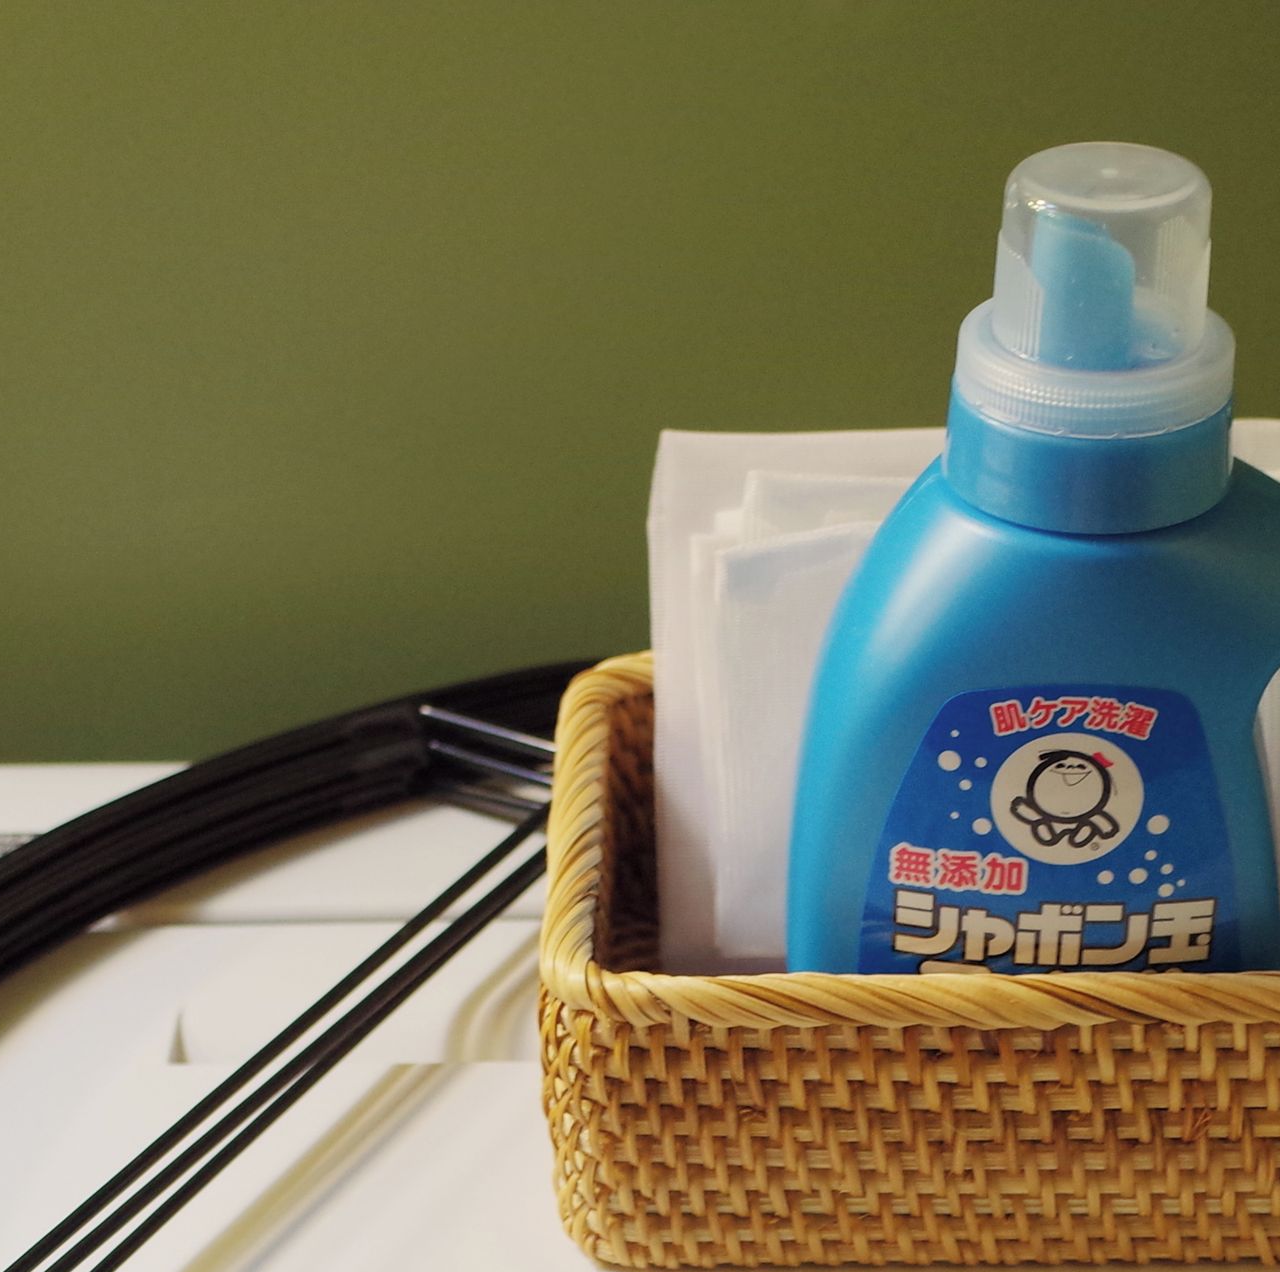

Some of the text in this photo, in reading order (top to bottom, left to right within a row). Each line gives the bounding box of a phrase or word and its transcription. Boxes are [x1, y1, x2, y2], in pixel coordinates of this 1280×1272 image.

[990, 697, 1158, 740] 肌ケア洗濯
[889, 843, 1027, 896] 無添加
[894, 889, 1216, 966] シャボン玉
